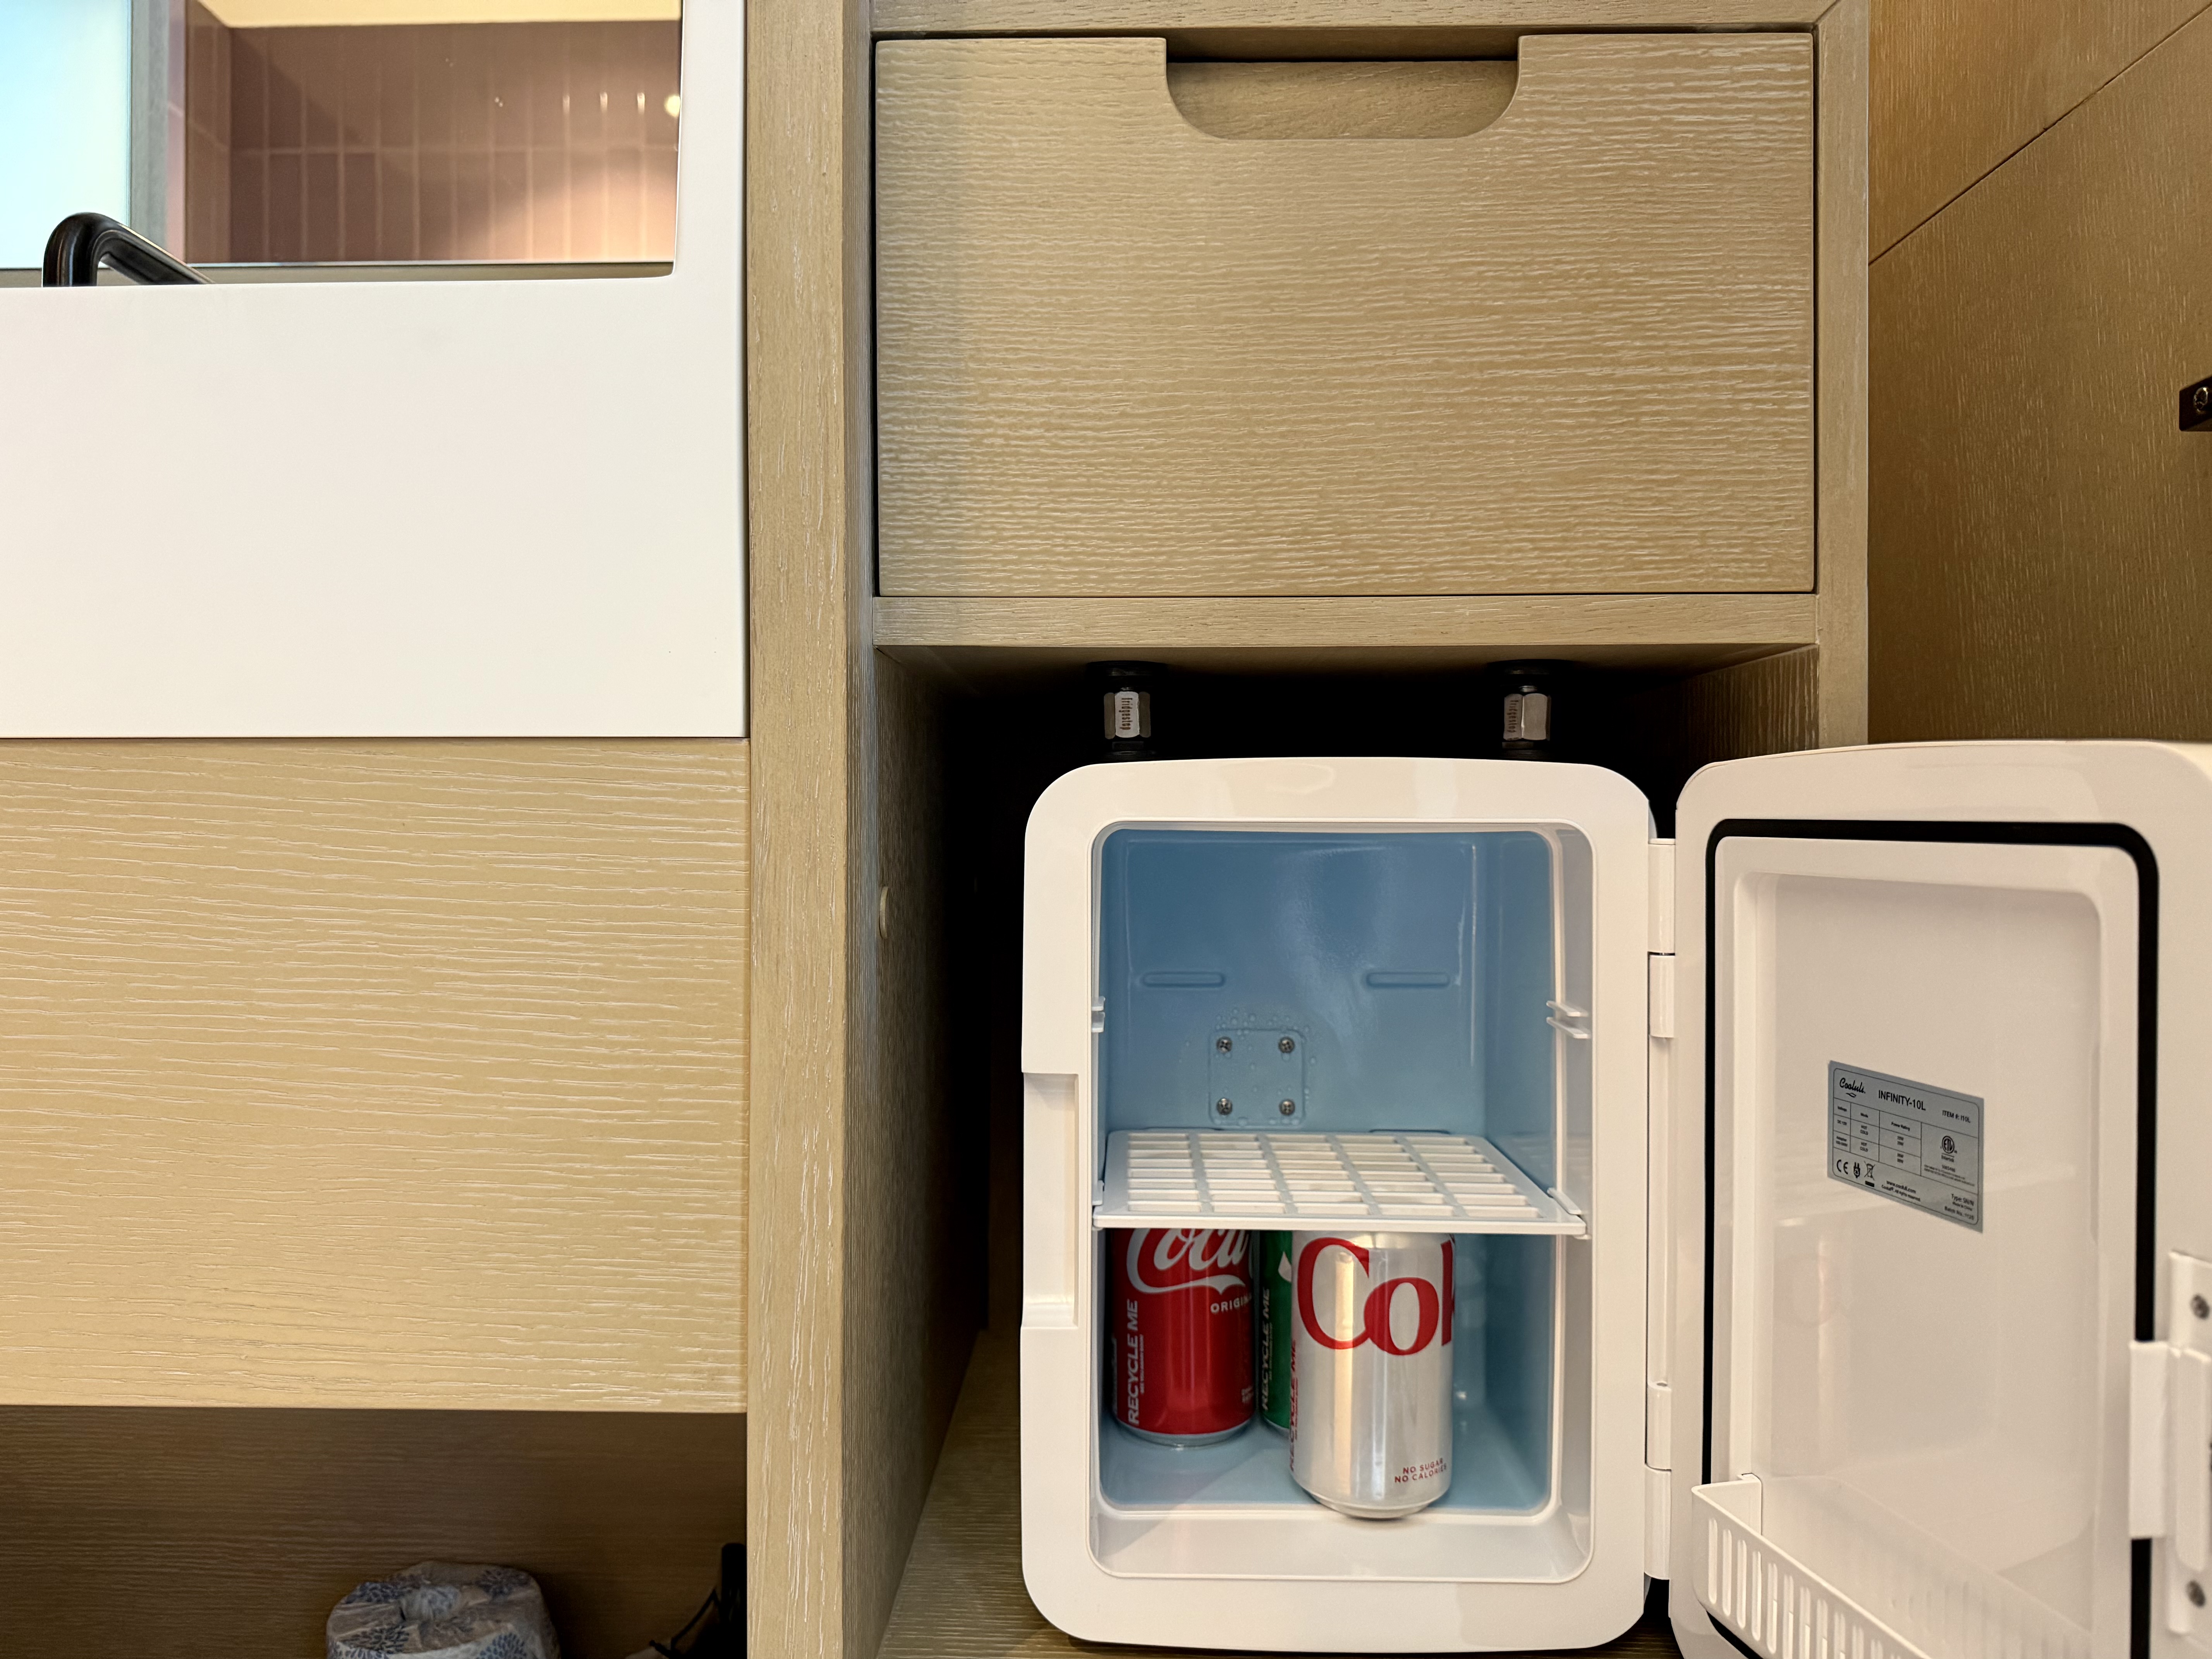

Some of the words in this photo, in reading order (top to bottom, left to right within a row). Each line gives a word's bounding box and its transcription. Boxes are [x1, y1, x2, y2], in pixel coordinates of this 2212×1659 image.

[1879, 1090, 1926, 1111] INFINITY-10L
[1942, 1110, 1954, 1118] ITEM
[1262, 1286, 1270, 1319] ME
[1127, 1299, 1138, 1331] ME
[1127, 1333, 1139, 1425] RECYCLE
[1412, 1463, 1447, 1480] CALORIES
[1419, 1457, 1443, 1471] SUGAR
